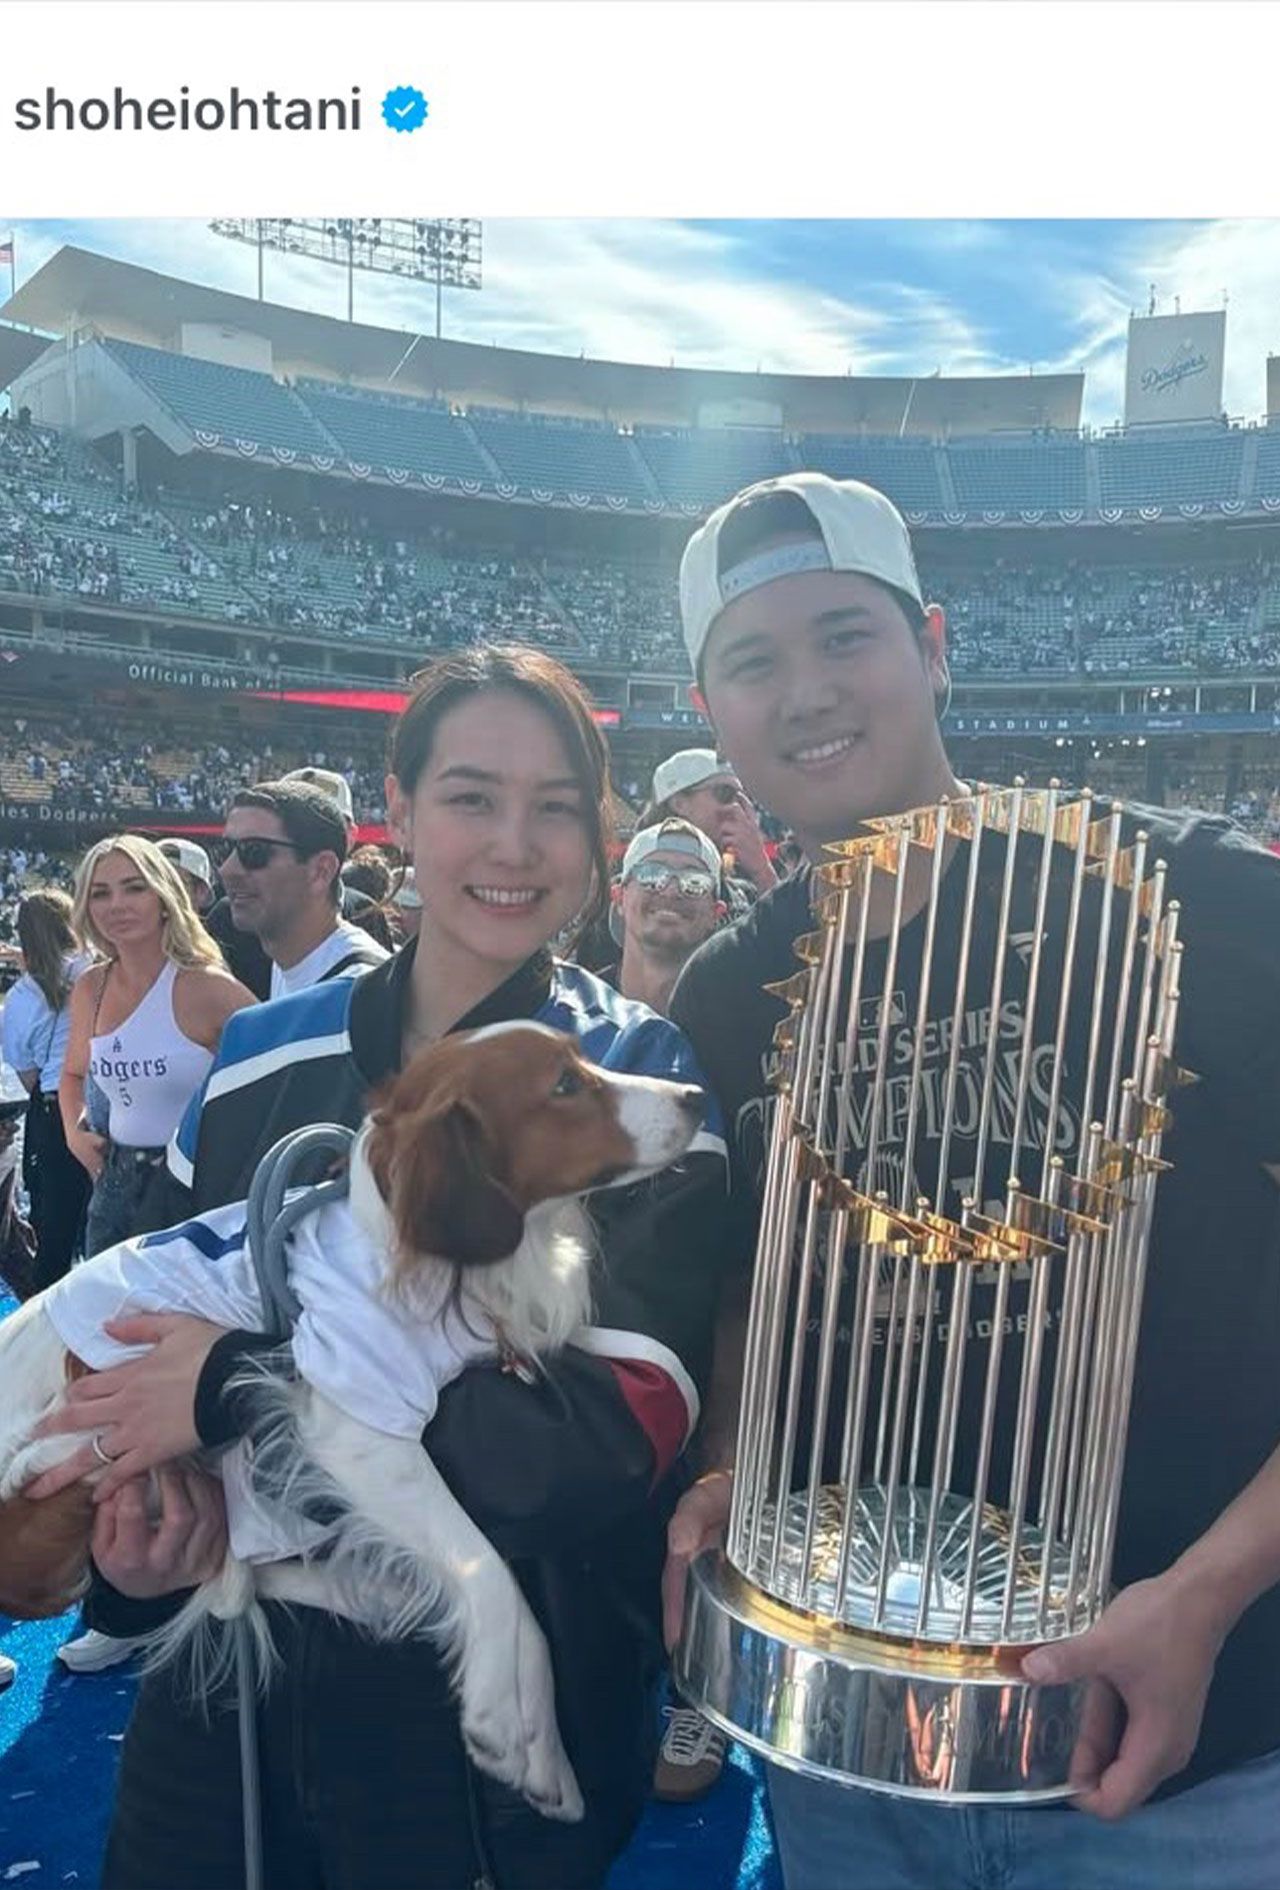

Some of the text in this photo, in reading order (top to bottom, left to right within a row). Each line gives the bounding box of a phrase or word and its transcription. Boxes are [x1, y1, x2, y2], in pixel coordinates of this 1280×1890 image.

[1141, 354, 1208, 392] Dodgers
[128, 664, 193, 685] Official
[201, 673, 239, 689] Bank
[957, 719, 1069, 730] STADIUM
[40, 804, 119, 821] Dodgers
[760, 1038, 880, 1084] WRLD
[735, 1043, 1081, 1160] CAMPIONS
